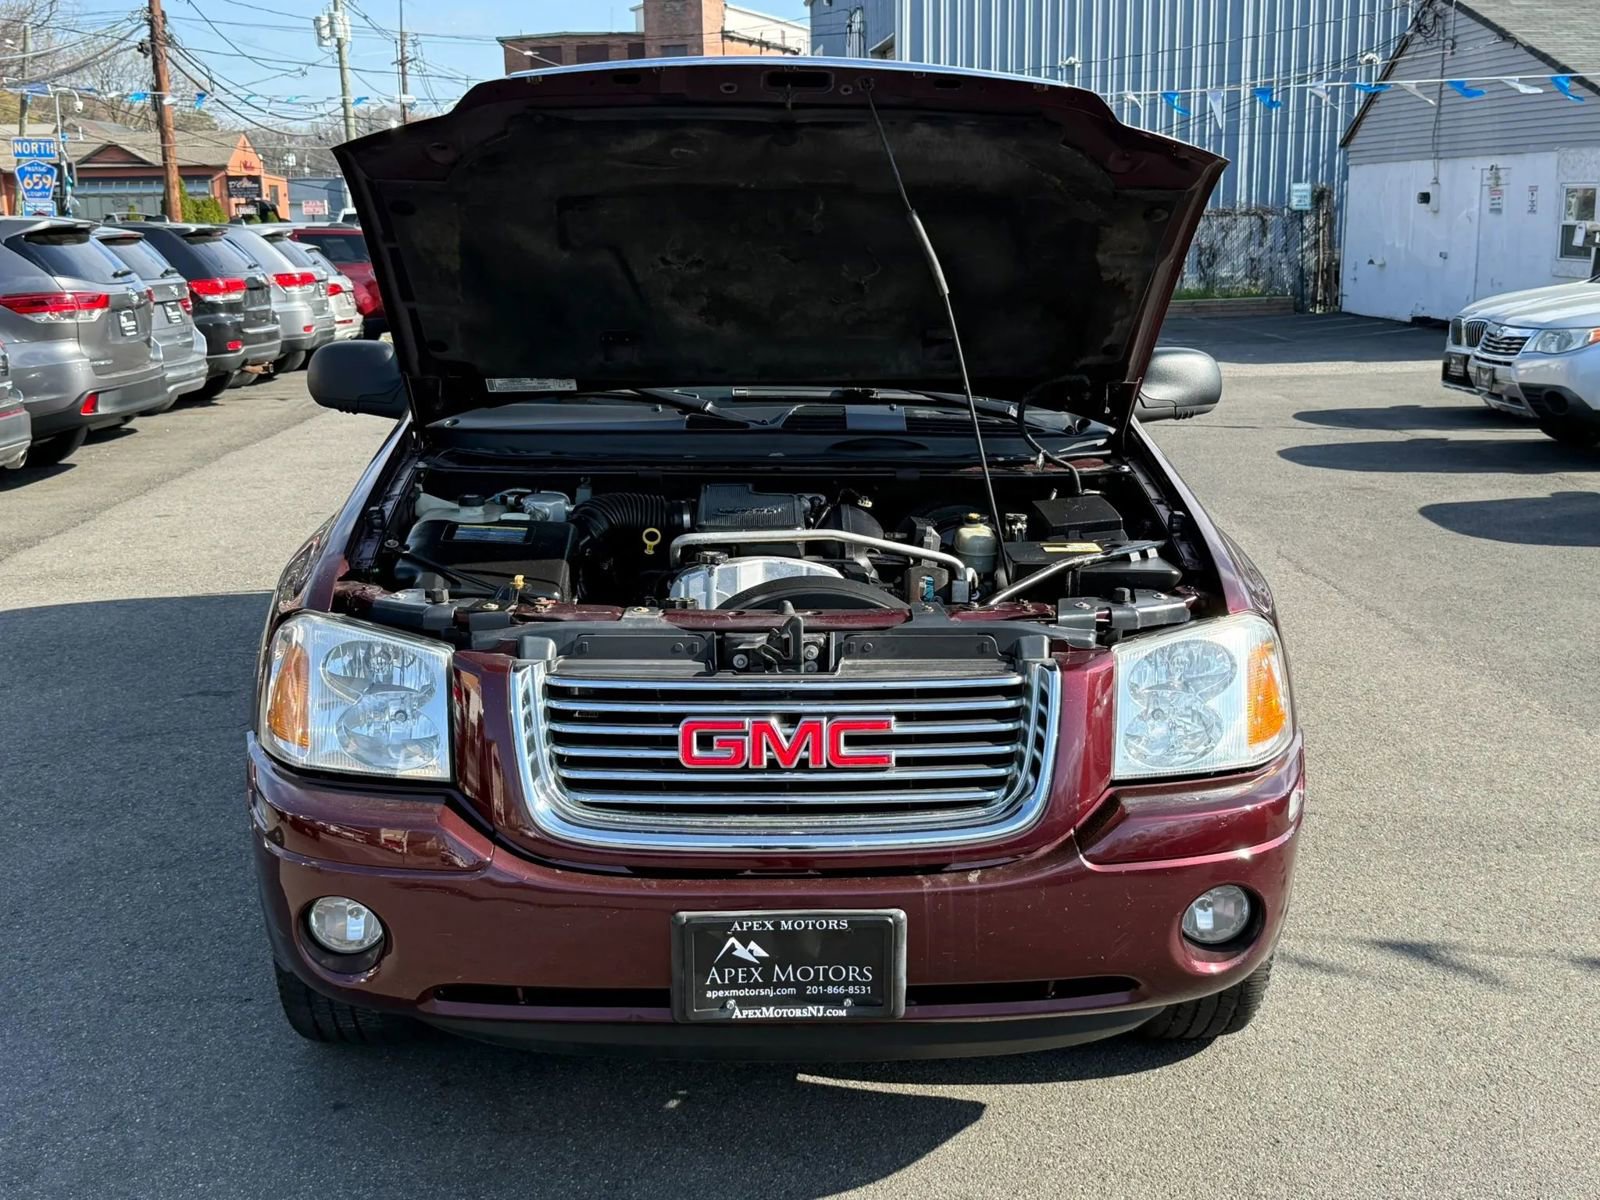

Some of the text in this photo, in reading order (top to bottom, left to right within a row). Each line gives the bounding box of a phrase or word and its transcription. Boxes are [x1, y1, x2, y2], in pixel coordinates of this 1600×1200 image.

[14, 142, 55, 154] NORTH
[24, 174, 52, 189] 659
[679, 716, 896, 768] GMC
[730, 919, 849, 932] APEX MOTORS
[706, 985, 872, 999] apexmotorsnj.com 201-866-8531
